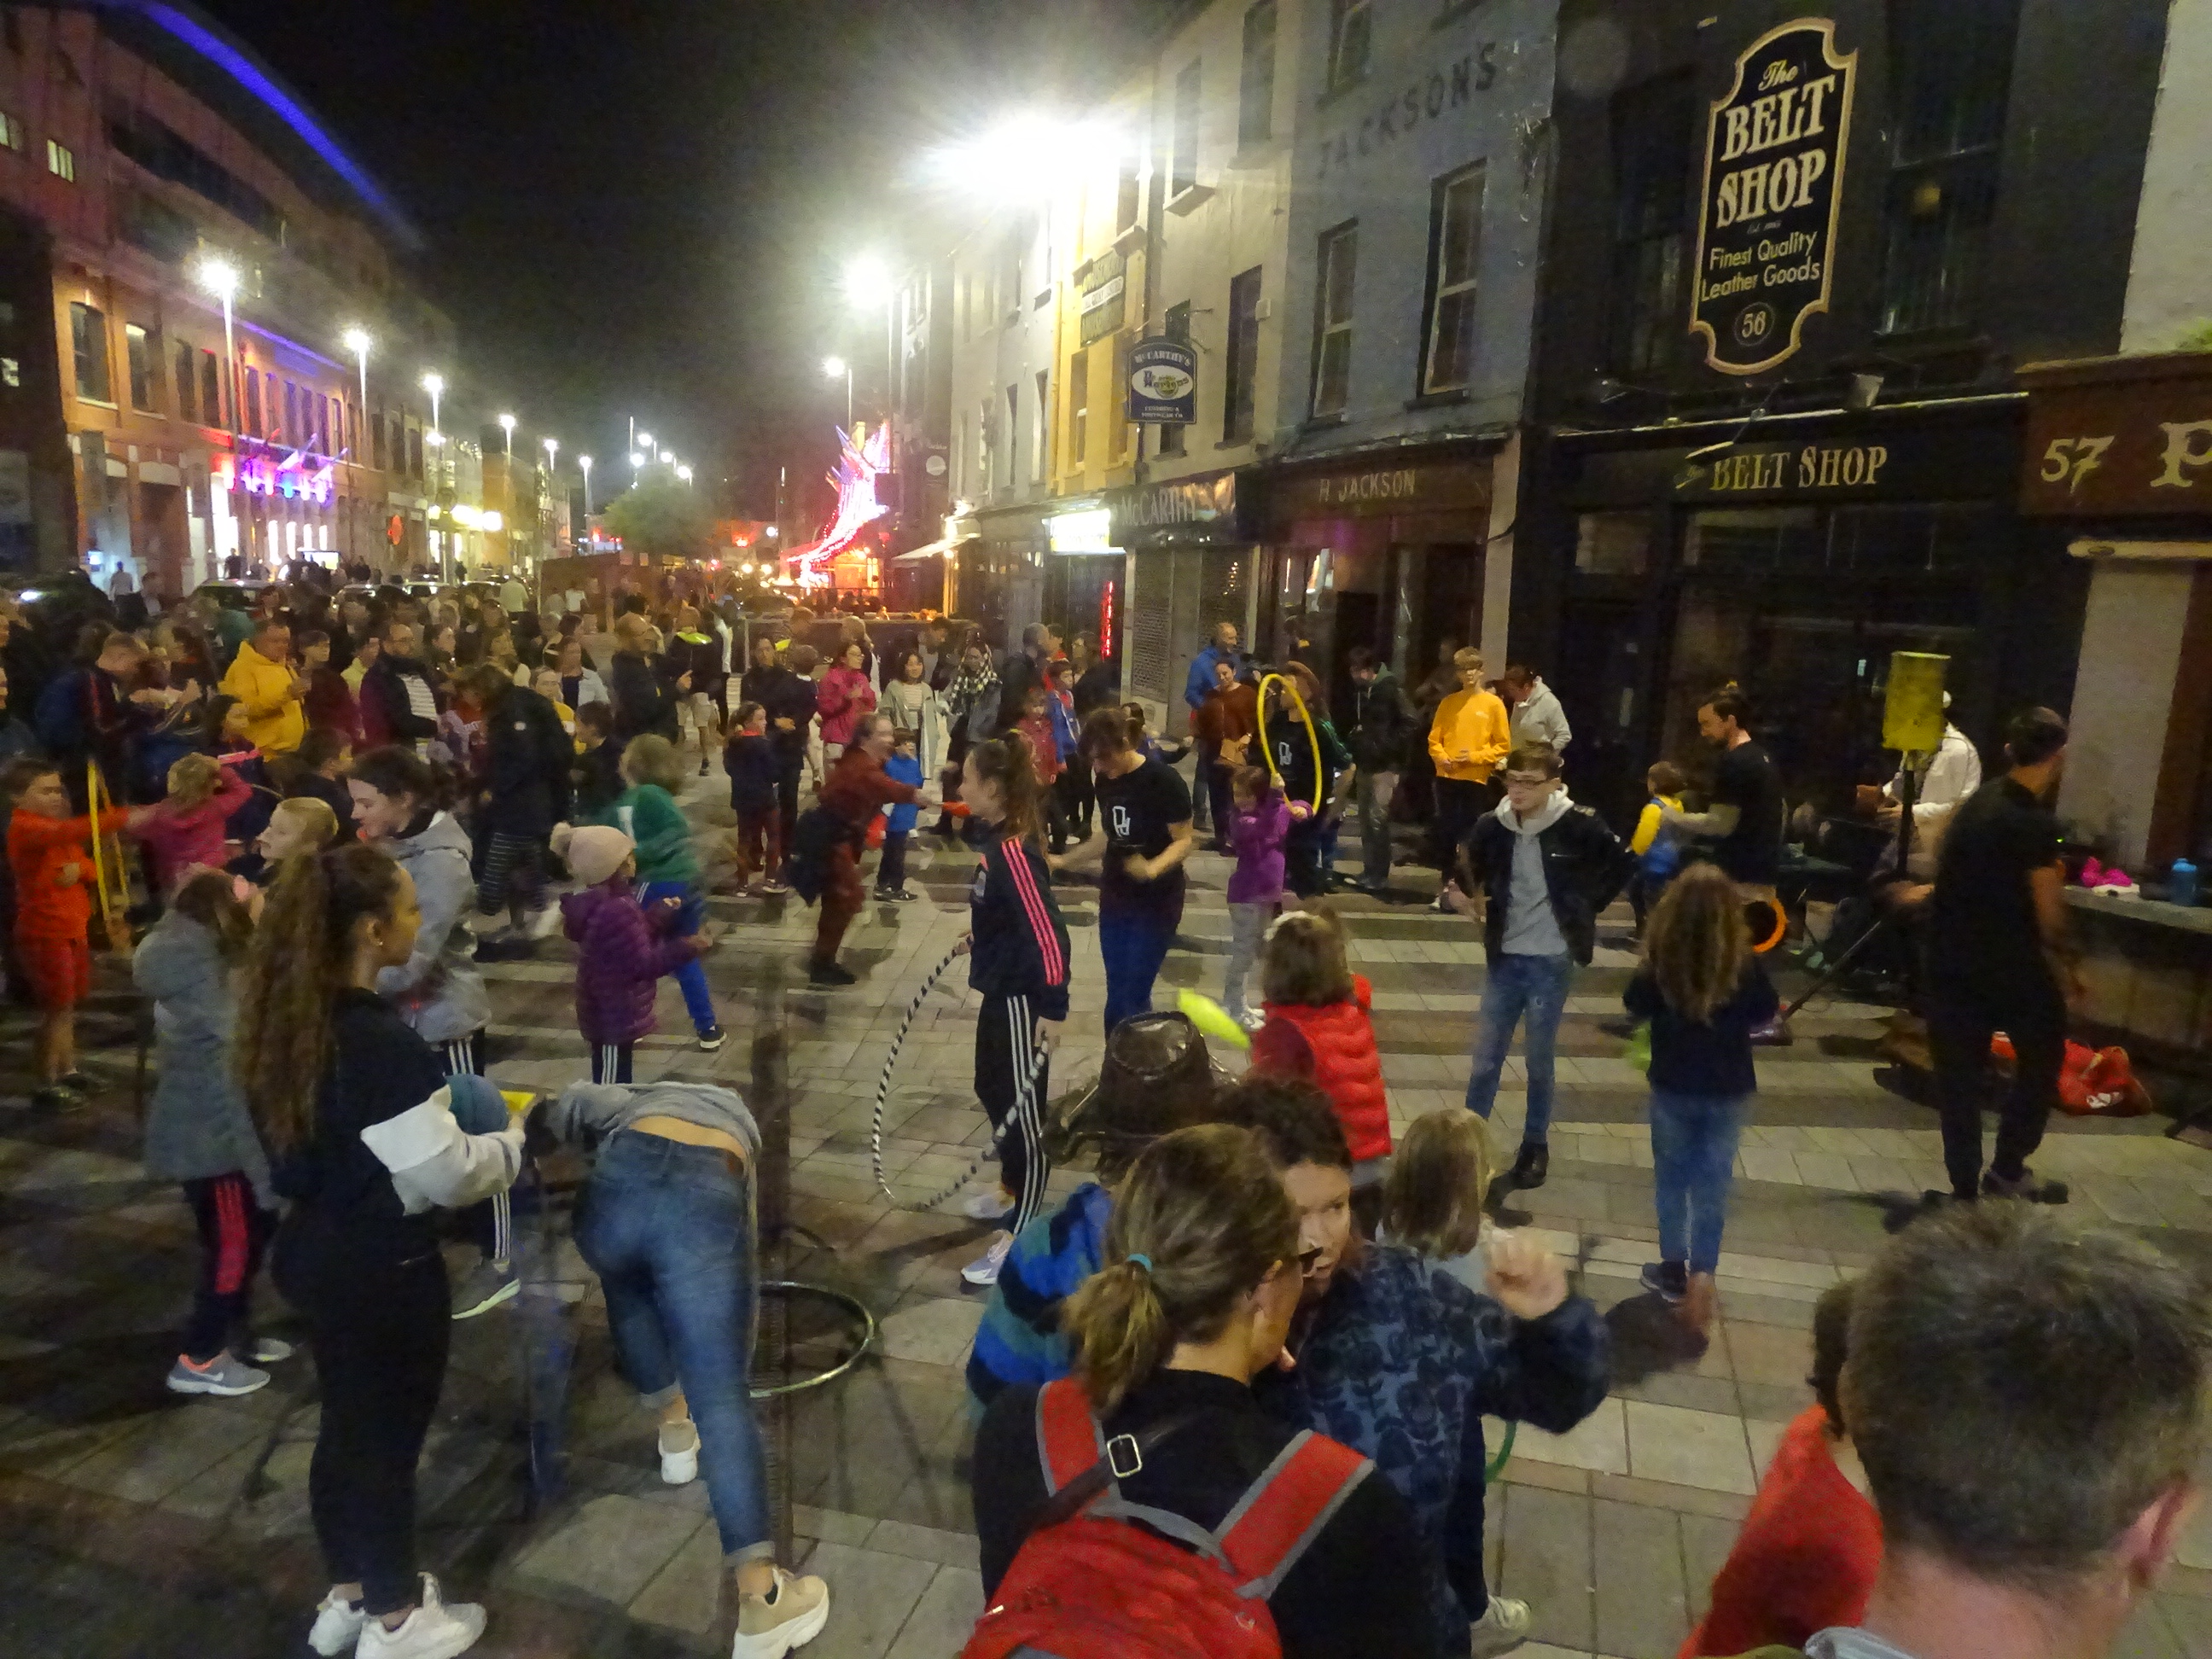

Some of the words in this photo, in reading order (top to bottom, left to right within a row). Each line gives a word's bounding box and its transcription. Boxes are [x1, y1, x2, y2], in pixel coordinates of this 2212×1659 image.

[1758, 59, 1798, 91] The
[1317, 42, 1497, 179] JACKSONS
[1720, 73, 1836, 161] BELT
[1716, 148, 1827, 230] SHOP
[1709, 246, 1753, 271] Finest
[1757, 230, 1819, 261] Quality
[1701, 271, 1758, 302] Leather
[1763, 256, 1821, 287] Goods
[1338, 469, 1416, 503] JACKSON
[1709, 452, 1791, 491] BELT
[1798, 445, 1888, 488] SHOP
[2040, 434, 2116, 496] 57
